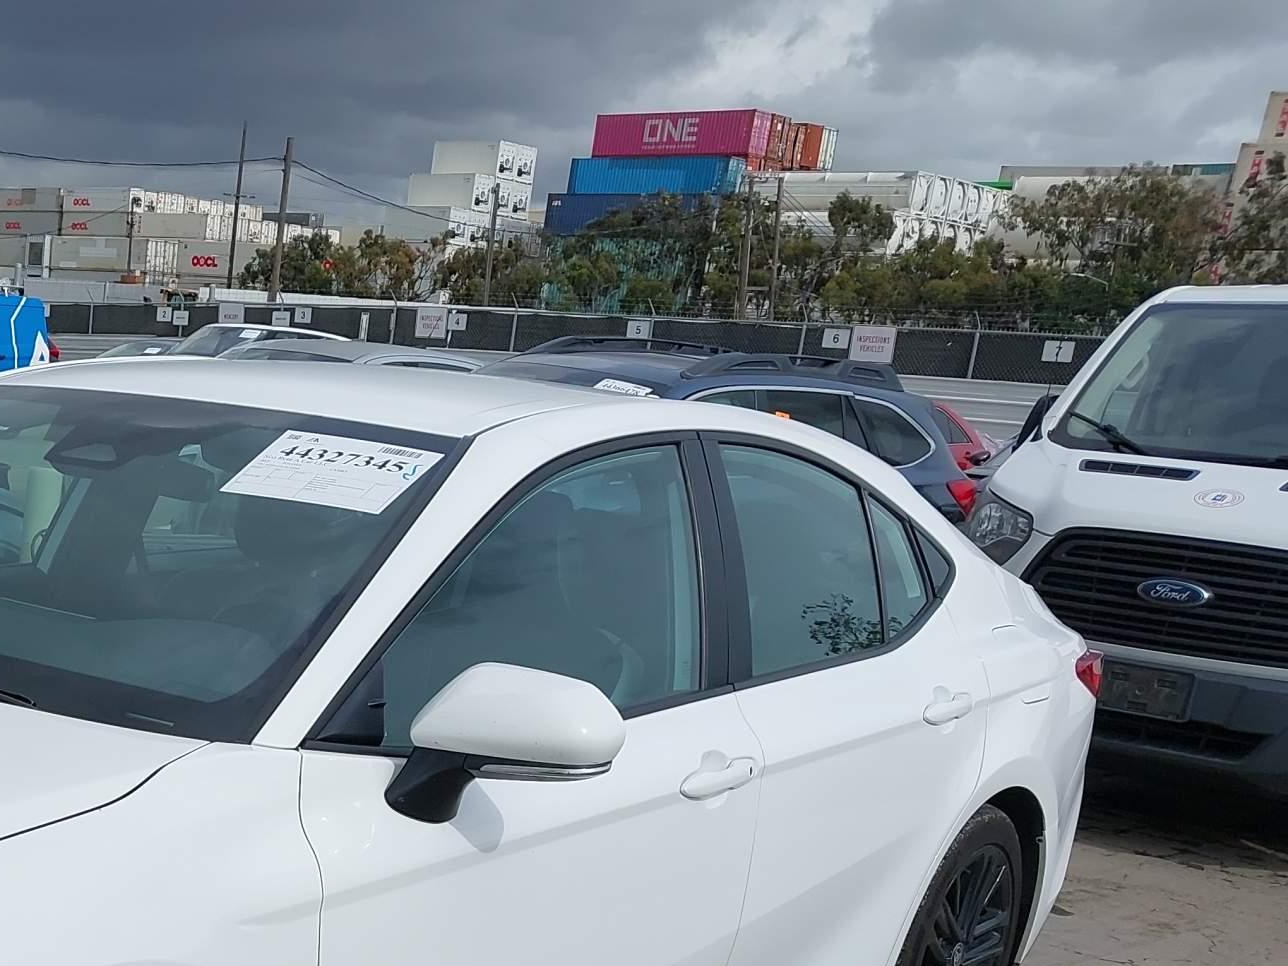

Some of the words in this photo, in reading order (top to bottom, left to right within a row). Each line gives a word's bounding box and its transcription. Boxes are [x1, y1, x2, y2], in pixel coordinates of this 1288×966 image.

[643, 118, 699, 142] ONE
[192, 255, 218, 268] OOCL
[161, 310, 167, 319] 2
[300, 310, 306, 320] 3
[454, 317, 460, 326] 4
[635, 325, 642, 335] 5
[832, 333, 840, 344] 6
[279, 445, 409, 473] 44327345
[1150, 583, 1191, 601] Ford
